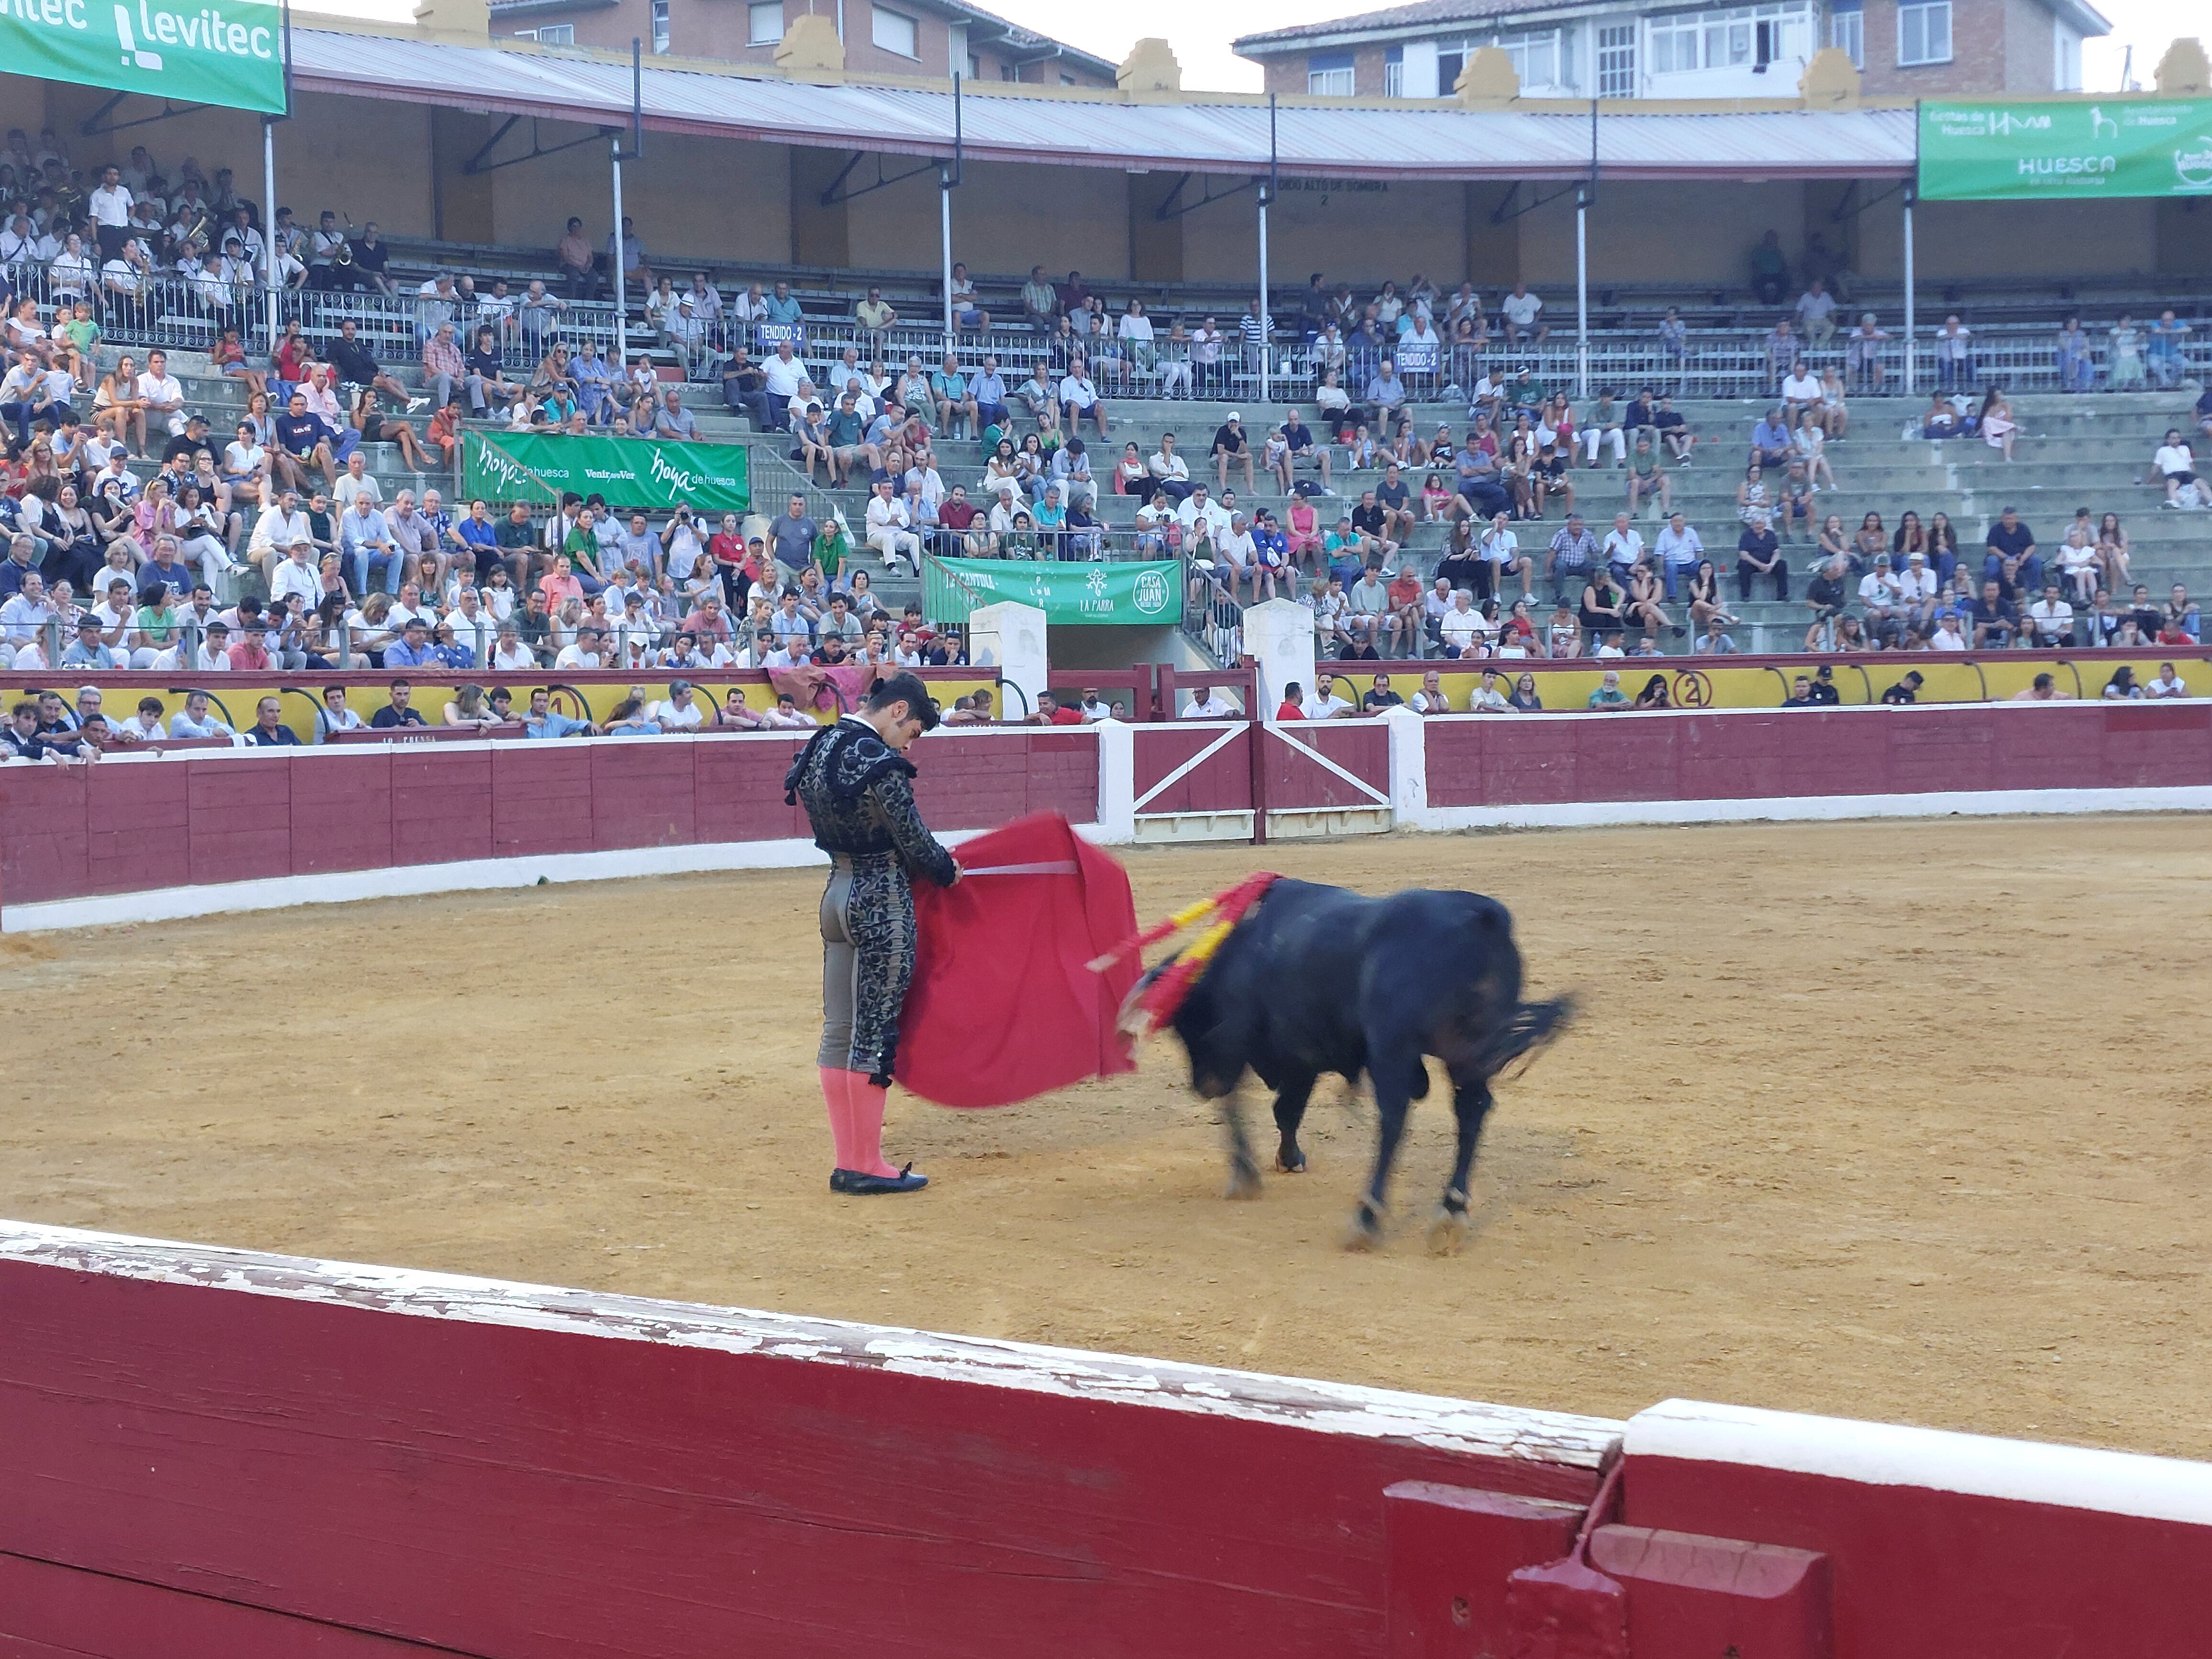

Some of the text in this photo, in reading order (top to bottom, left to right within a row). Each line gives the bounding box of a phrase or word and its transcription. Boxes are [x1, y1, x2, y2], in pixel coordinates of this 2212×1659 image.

[139, 0, 271, 58] levitec
[2019, 155, 2116, 174] HUESCA
[761, 325, 792, 341] TENDIDO
[477, 440, 526, 494] hoya
[585, 469, 610, 478] Venir
[619, 471, 635, 479] Ver
[651, 448, 696, 500] hoya
[1141, 576, 1161, 588] CASA
[1139, 588, 1161, 604] JUAN
[1080, 599, 1114, 612] LA PARRA
[1685, 678, 1699, 703] 2
[551, 697, 562, 715] 1
